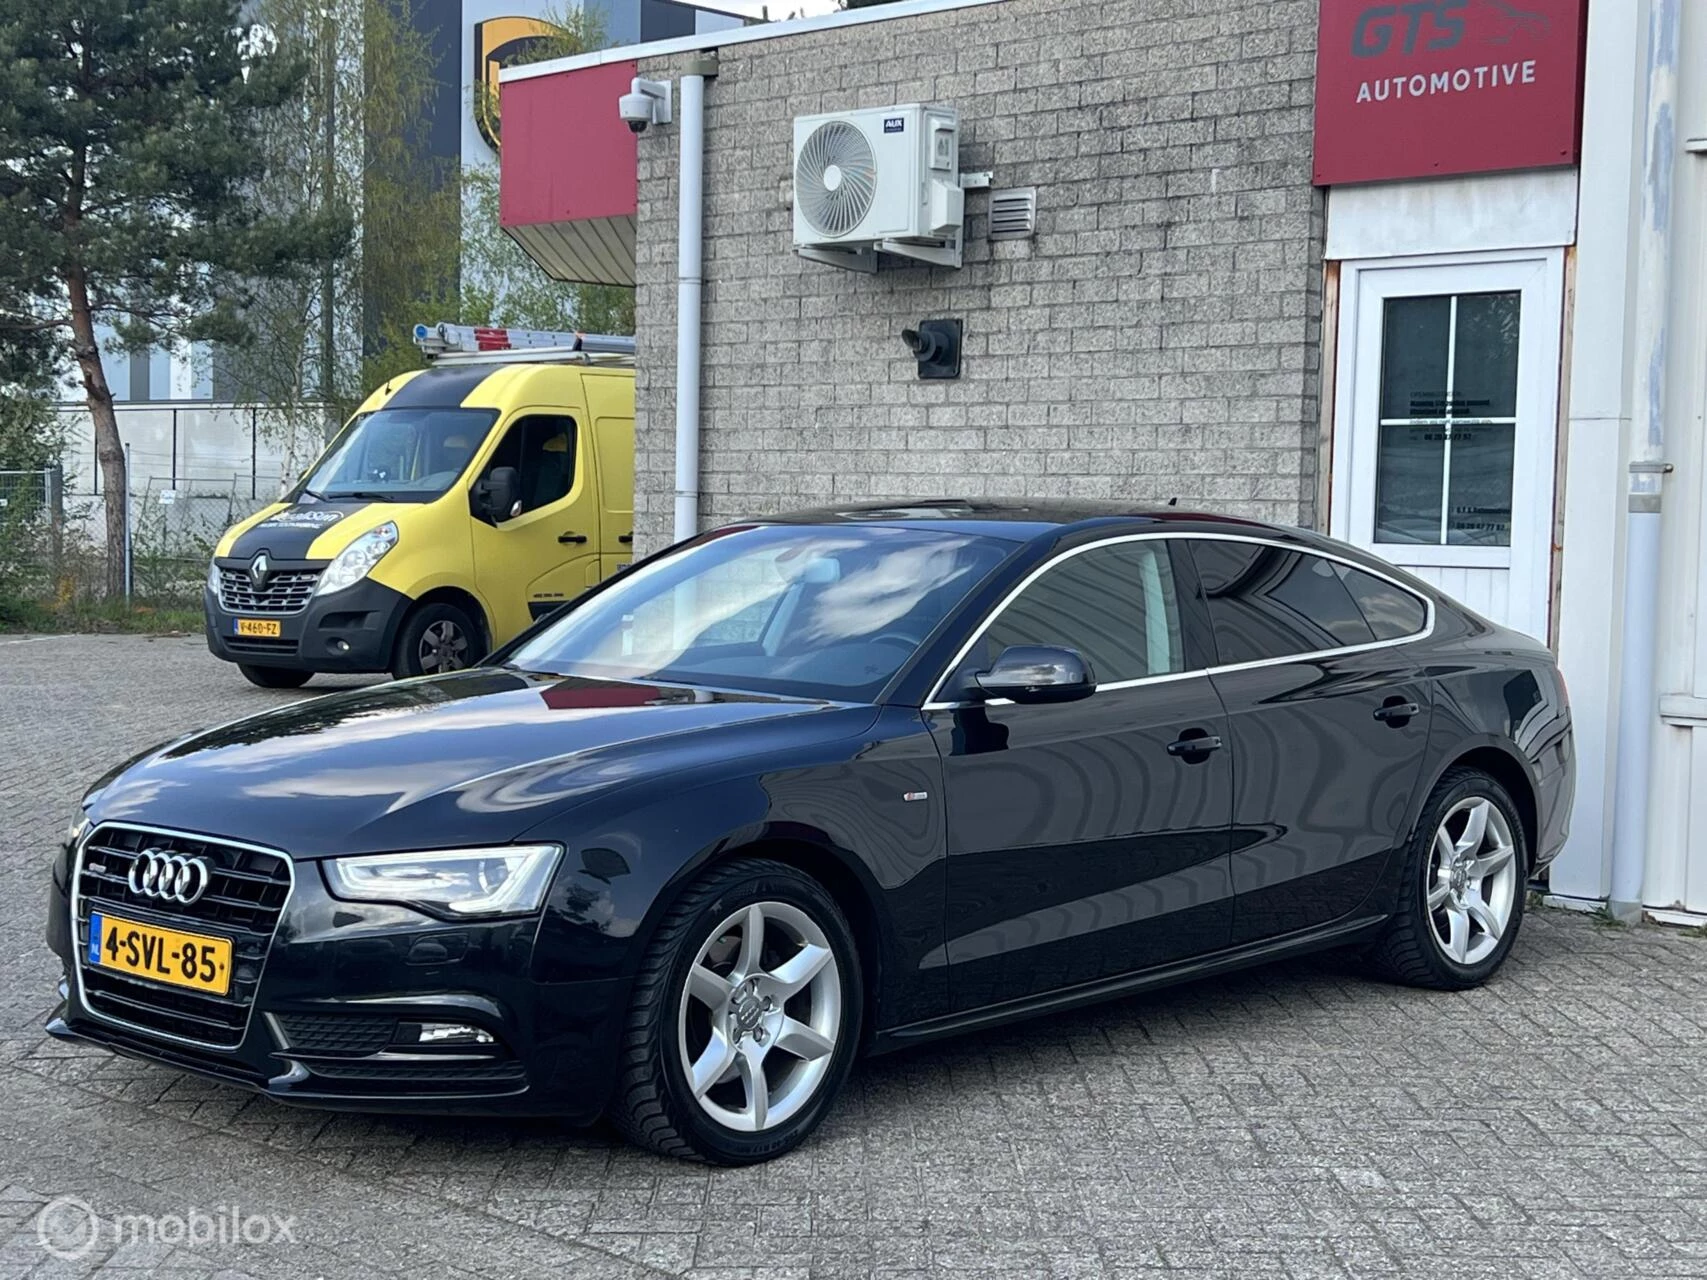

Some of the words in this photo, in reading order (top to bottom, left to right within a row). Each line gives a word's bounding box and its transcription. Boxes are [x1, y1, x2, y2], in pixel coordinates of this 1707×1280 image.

[1351, 0, 1470, 58] GTS
[1355, 59, 1536, 104] AUTOMOTIVE
[885, 119, 902, 128] AUX
[105, 926, 217, 984] 4-SVL-85
